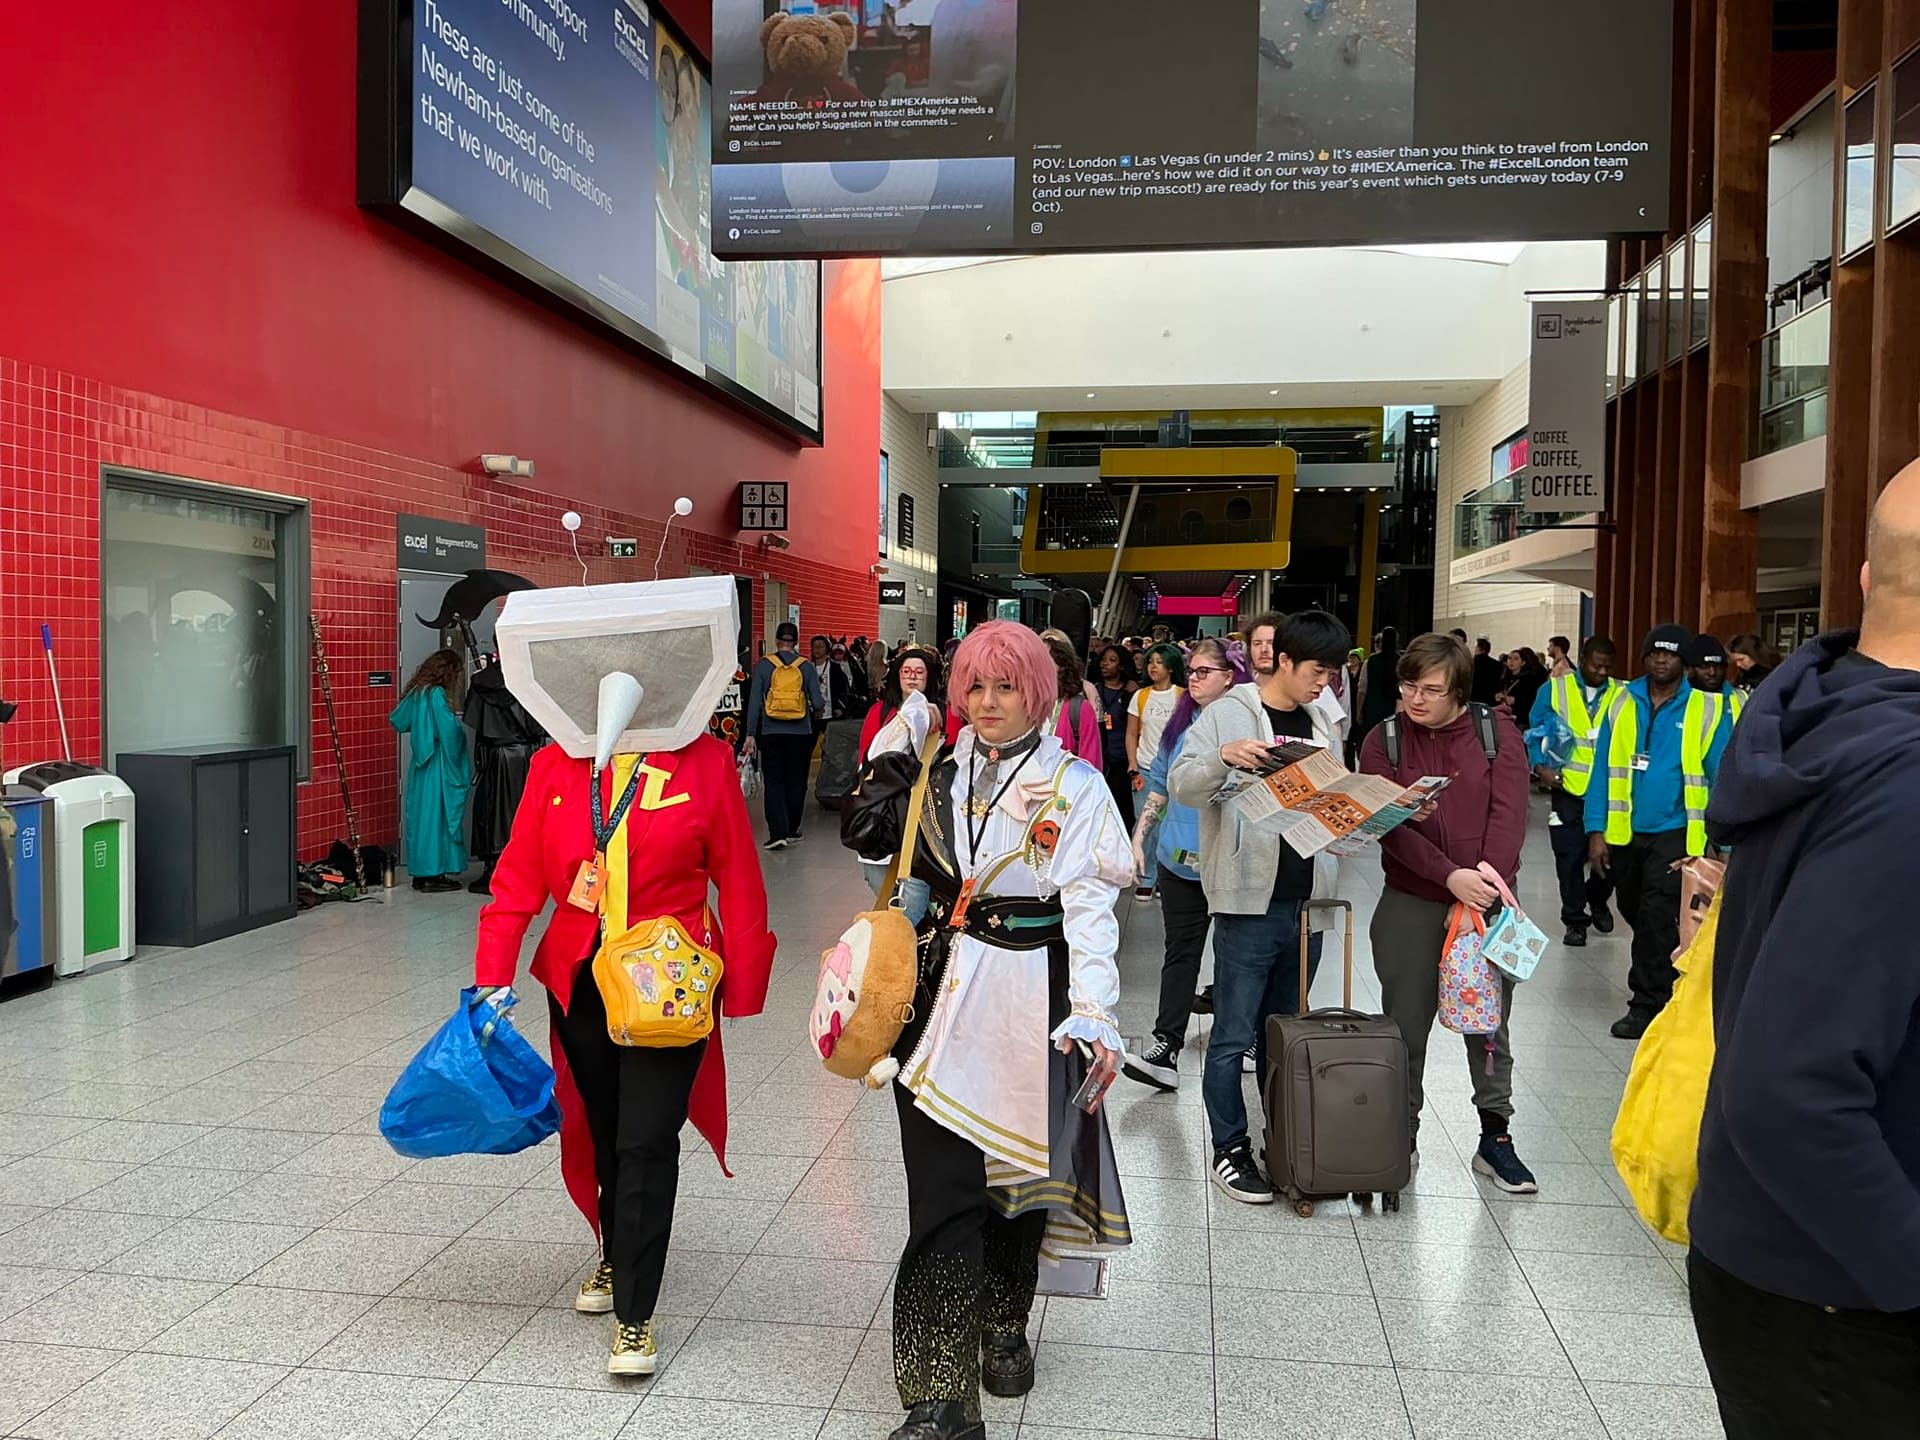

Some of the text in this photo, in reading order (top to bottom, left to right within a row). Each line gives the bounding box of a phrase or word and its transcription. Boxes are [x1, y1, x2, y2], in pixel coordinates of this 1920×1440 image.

[502, 0, 566, 61] mmunity.
[545, 0, 588, 43] upport
[424, 0, 594, 163] These are just some of the
[729, 103, 757, 111] NAME
[825, 100, 841, 109] For
[860, 99, 877, 108] trip
[878, 99, 888, 107] to
[890, 97, 959, 106] #IMEXAmerica
[961, 96, 978, 104] this
[729, 114, 751, 122] year,
[780, 111, 812, 121] bought
[814, 111, 839, 120] along
[869, 108, 905, 117] mascot!
[907, 108, 923, 116] But
[925, 106, 957, 116] he/she
[958, 105, 986, 114] needs
[422, 43, 613, 215] Newham-based organisations
[729, 123, 756, 132] name!
[758, 123, 776, 131] Can
[777, 123, 794, 132] you
[796, 121, 820, 131] help?
[822, 120, 872, 130] Suggestion
[873, 120, 882, 128] in
[884, 119, 899, 127] the
[901, 118, 948, 127] comments
[421, 93, 552, 211] that we work with.
[1033, 140, 1649, 169] POV: London Las Vegas (in under 2 mins) It's easier than you think to travel from London
[1033, 173, 1046, 184] to
[1050, 172, 1071, 183] Las
[1164, 168, 1191, 180] how
[1196, 169, 1214, 179] we
[1218, 167, 1239, 178] did
[1243, 166, 1252, 177] it
[1255, 168, 1272, 177] on
[1276, 167, 1297, 176] our
[1301, 165, 1329, 177] way
[1332, 164, 1347, 175] to
[1350, 160, 1456, 174] #IMEXAmerica.
[1460, 158, 1486, 170] The
[1488, 156, 1590, 169] #ExcelLondon
[1593, 156, 1629, 167] team
[1032, 170, 1624, 199] (and our new trip mascot!) are ready for this year's event which gets underway today (7-9
[1032, 201, 1064, 214] Oct).
[1532, 450, 1582, 469] COFFEE,
[1532, 475, 1597, 497] COFFEE.
[404, 534, 428, 549] excel
[882, 589, 904, 597] DSV
